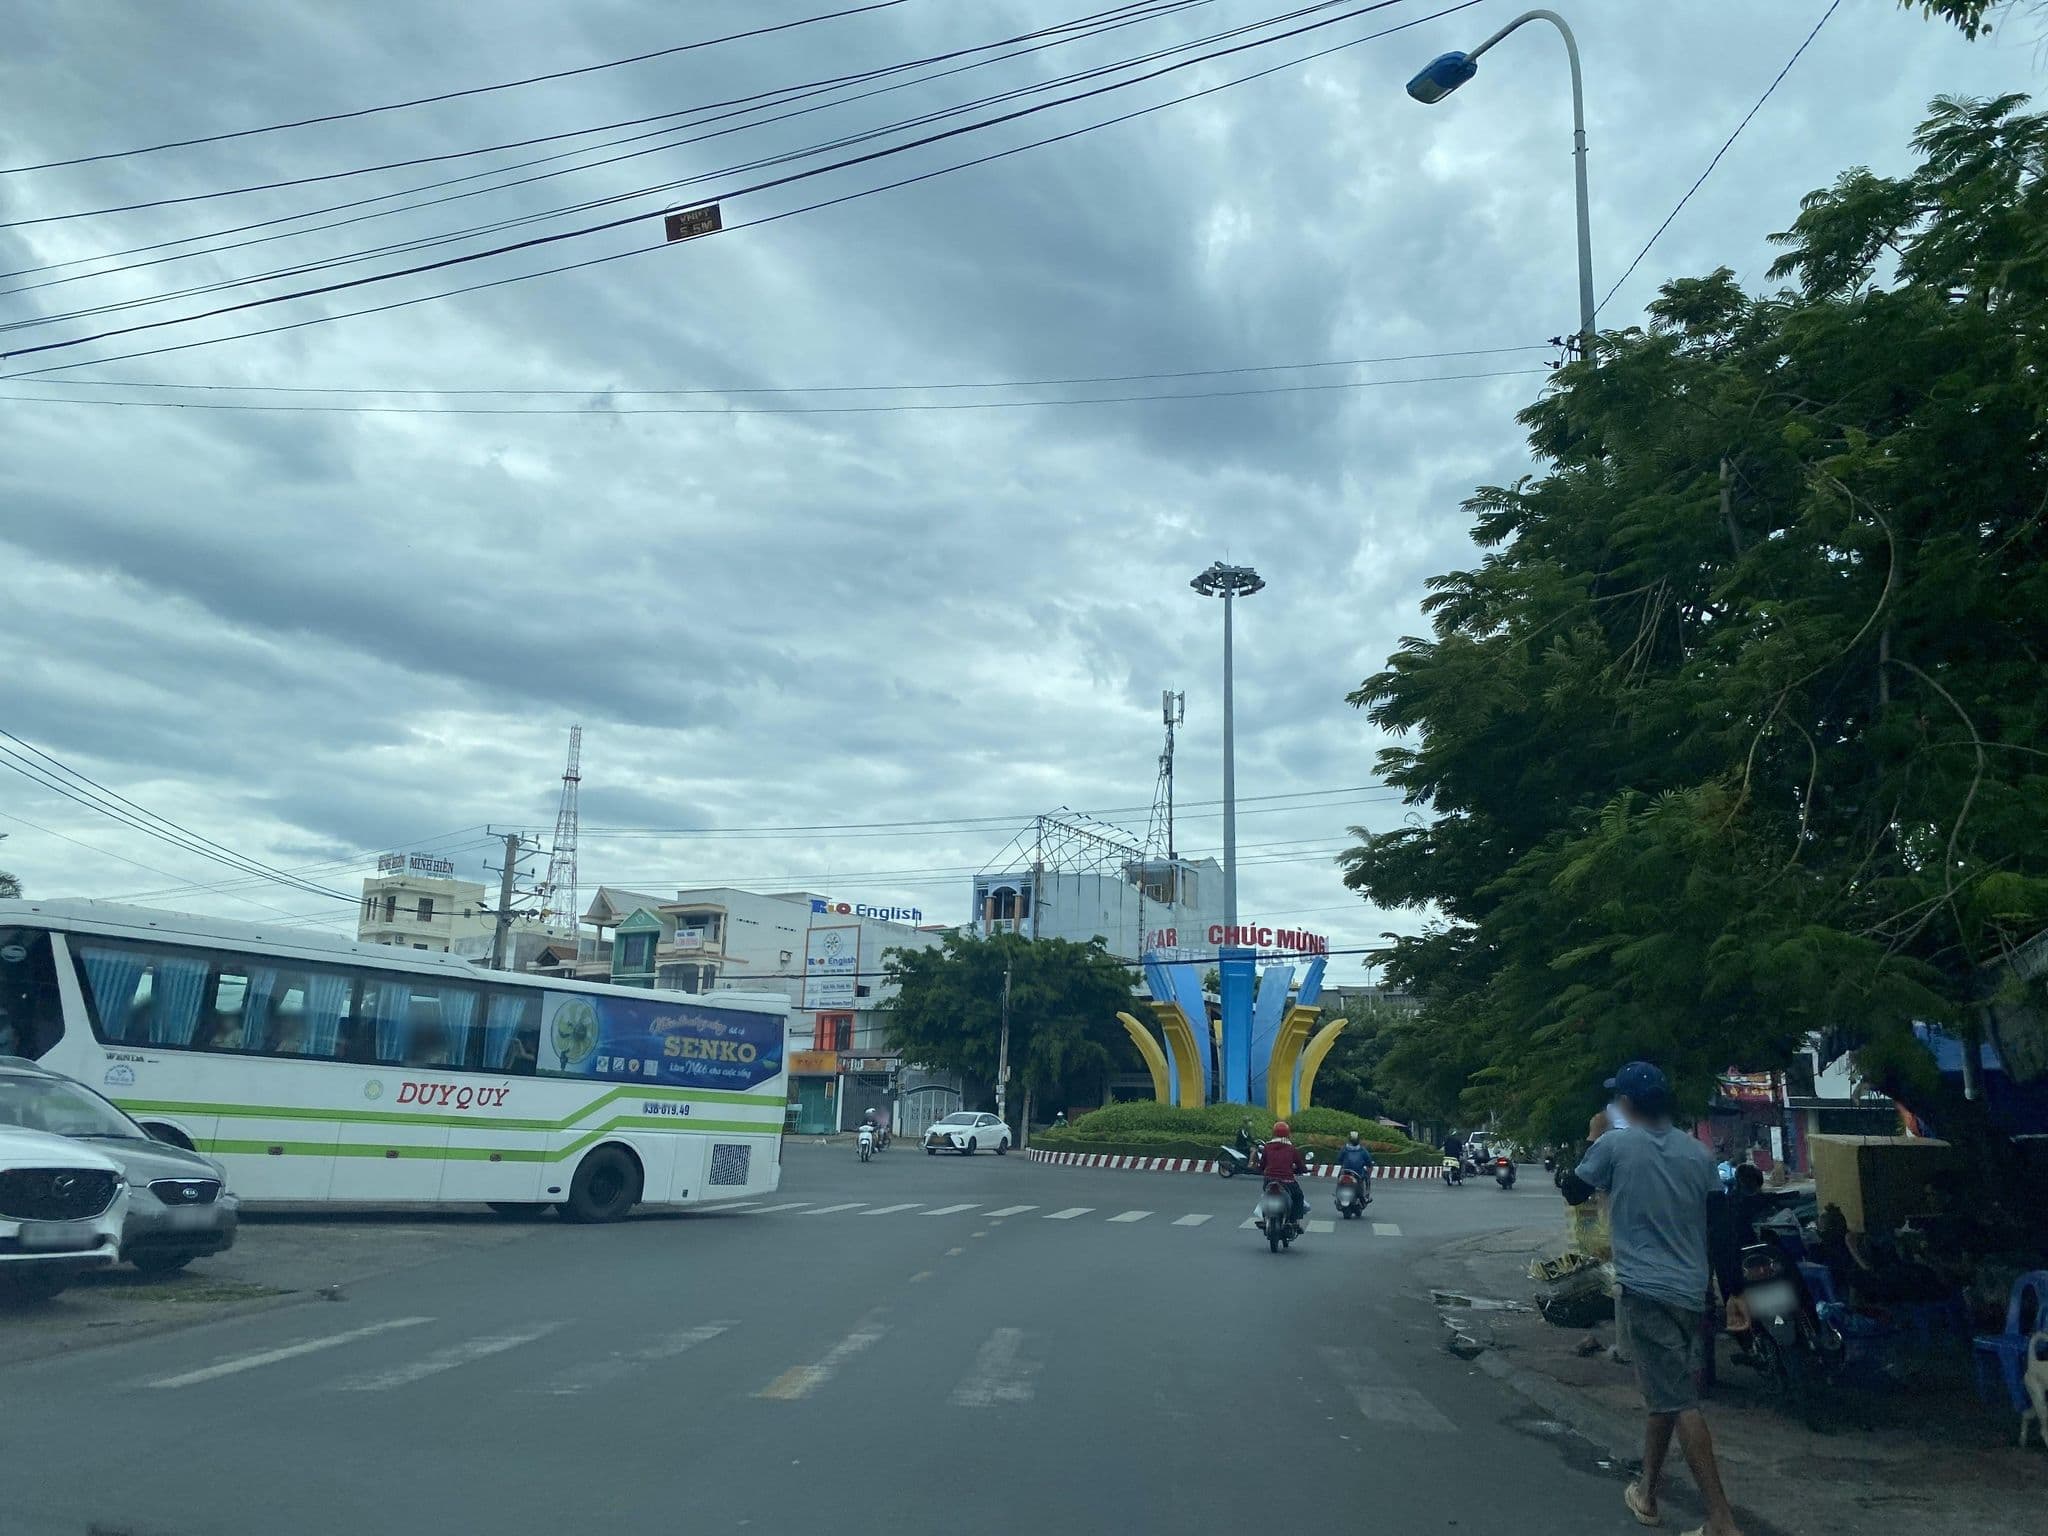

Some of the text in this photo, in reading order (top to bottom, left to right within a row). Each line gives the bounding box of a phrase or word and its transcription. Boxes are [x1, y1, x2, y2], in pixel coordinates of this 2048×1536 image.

[410, 857, 432, 871] MINH
[856, 903, 922, 922] English
[1208, 921, 1326, 954] CHÚC MỪNG
[828, 956, 857, 966] English
[663, 1035, 757, 1063] SENKO
[396, 1081, 510, 1110] DUY QUÝ
